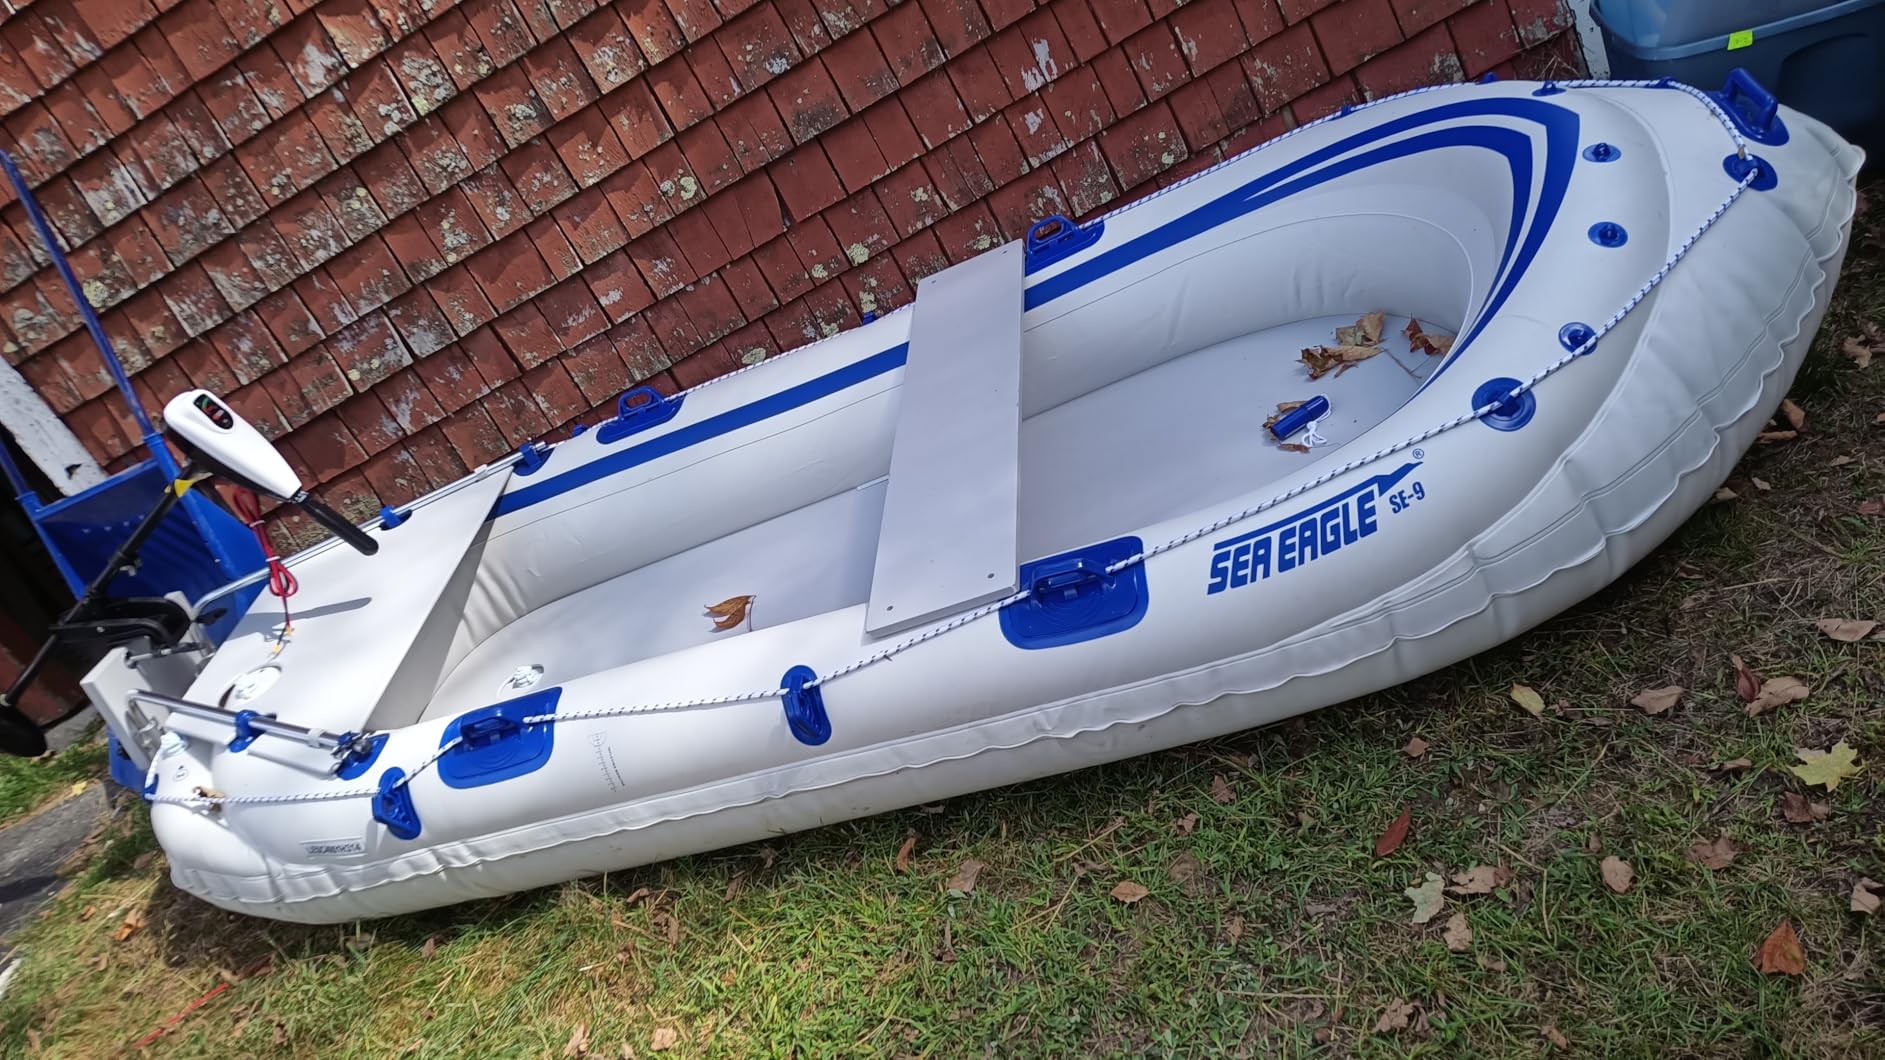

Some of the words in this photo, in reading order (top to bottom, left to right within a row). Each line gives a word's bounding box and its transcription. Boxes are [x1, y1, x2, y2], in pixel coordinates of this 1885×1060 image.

[1389, 481, 1426, 514] SE-9
[1207, 536, 1272, 596] SEA
[1278, 489, 1378, 573] EAGLE
